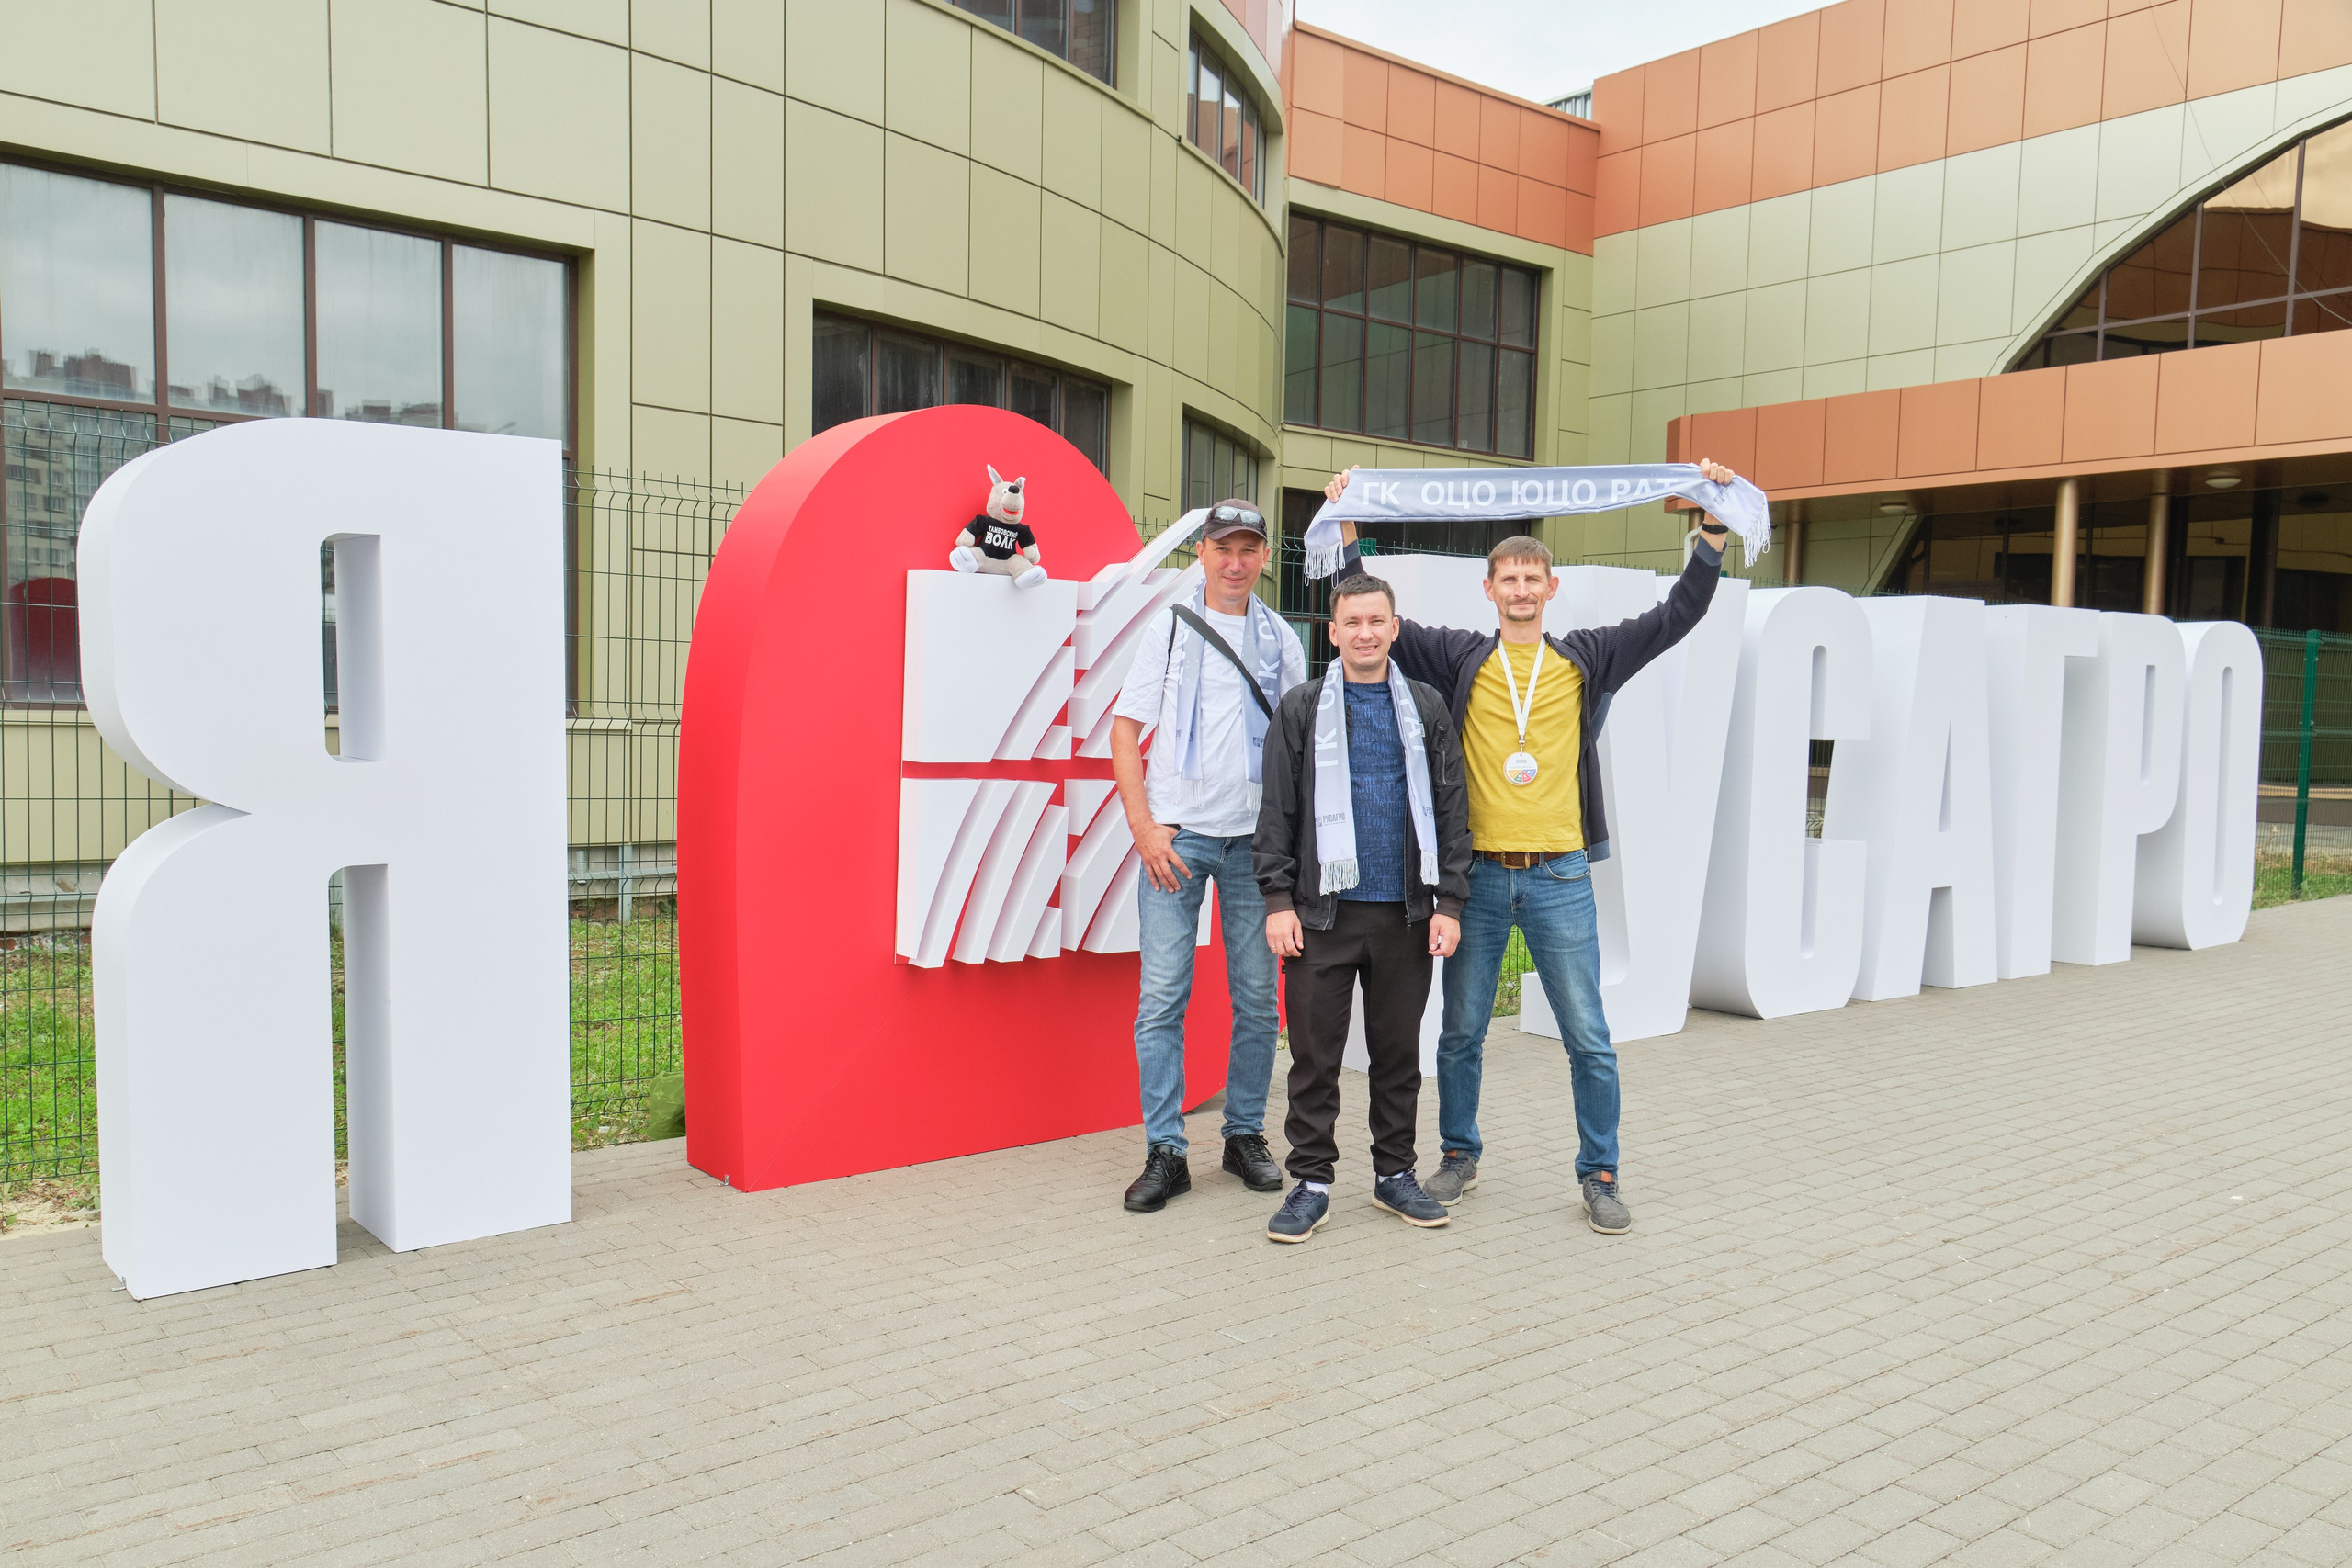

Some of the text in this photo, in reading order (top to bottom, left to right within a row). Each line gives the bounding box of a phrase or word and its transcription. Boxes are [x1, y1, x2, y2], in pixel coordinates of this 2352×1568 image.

[1363, 481, 1401, 506] ГК
[1420, 480, 1497, 510] ОЦО
[1511, 479, 1597, 506] ЮЦО
[984, 531, 1018, 550] ВОЛК
[988, 525, 1019, 538] ТАМБОВСКИЙ
[1315, 727, 1339, 769] ГК
[1322, 812, 1346, 824] РУСАГРО
[78, 417, 572, 1301] Я
